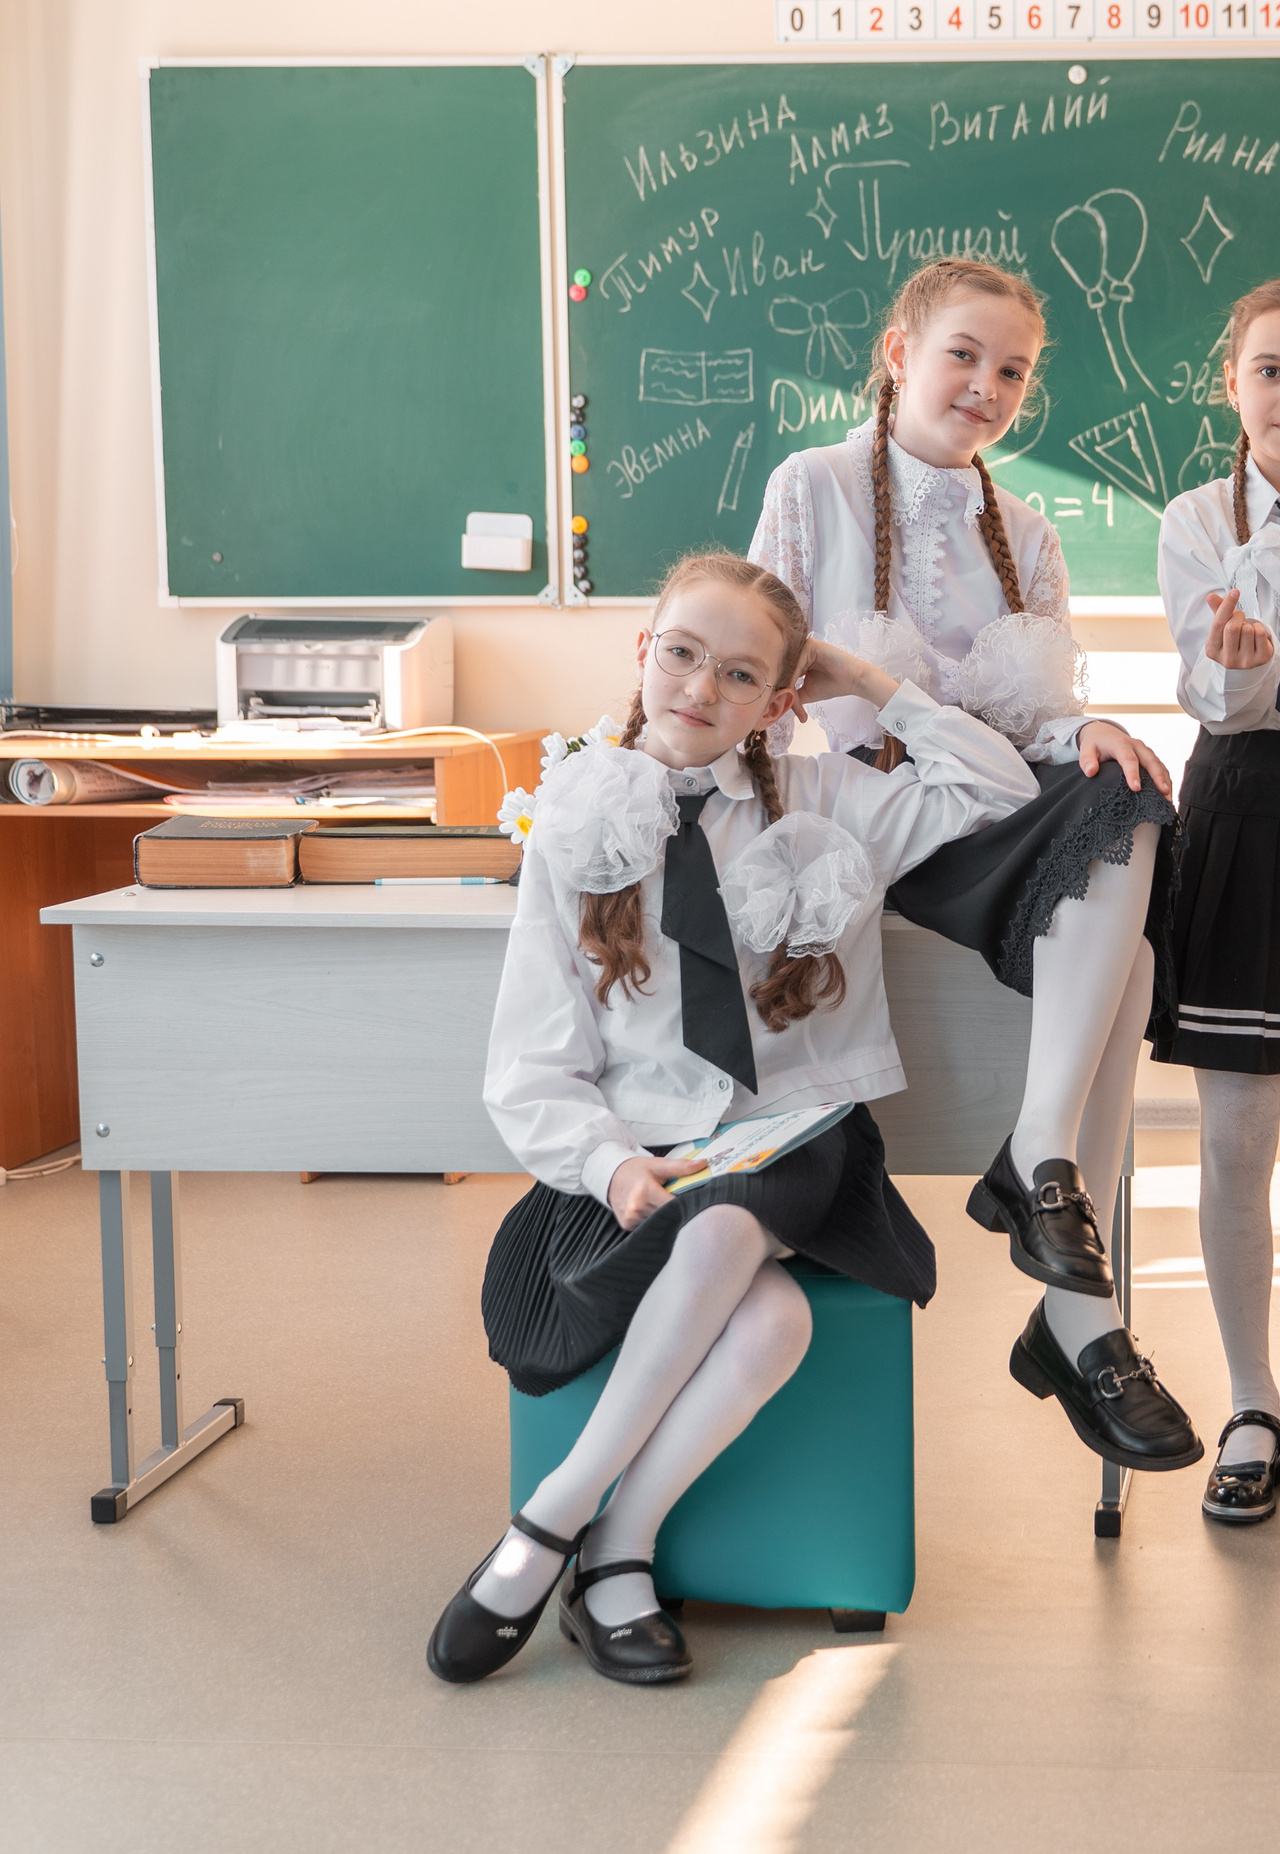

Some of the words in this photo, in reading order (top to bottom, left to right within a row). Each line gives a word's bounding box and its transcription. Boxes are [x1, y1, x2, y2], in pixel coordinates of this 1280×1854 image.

[791, 8, 804, 31] 0
[832, 8, 842, 31] 1
[870, 7, 883, 31] 2
[909, 7, 922, 30] 3
[948, 6, 962, 30] 4
[988, 6, 1001, 30] 5
[1028, 5, 1042, 29] 6
[1068, 5, 1081, 29] 7
[1107, 4, 1121, 29] 8
[1147, 4, 1161, 28] 9
[1180, 4, 1209, 28] 10
[1222, 4, 1247, 28] 11
[789, 103, 894, 185] АЛМАЗ
[722, 231, 826, 297] Иван
